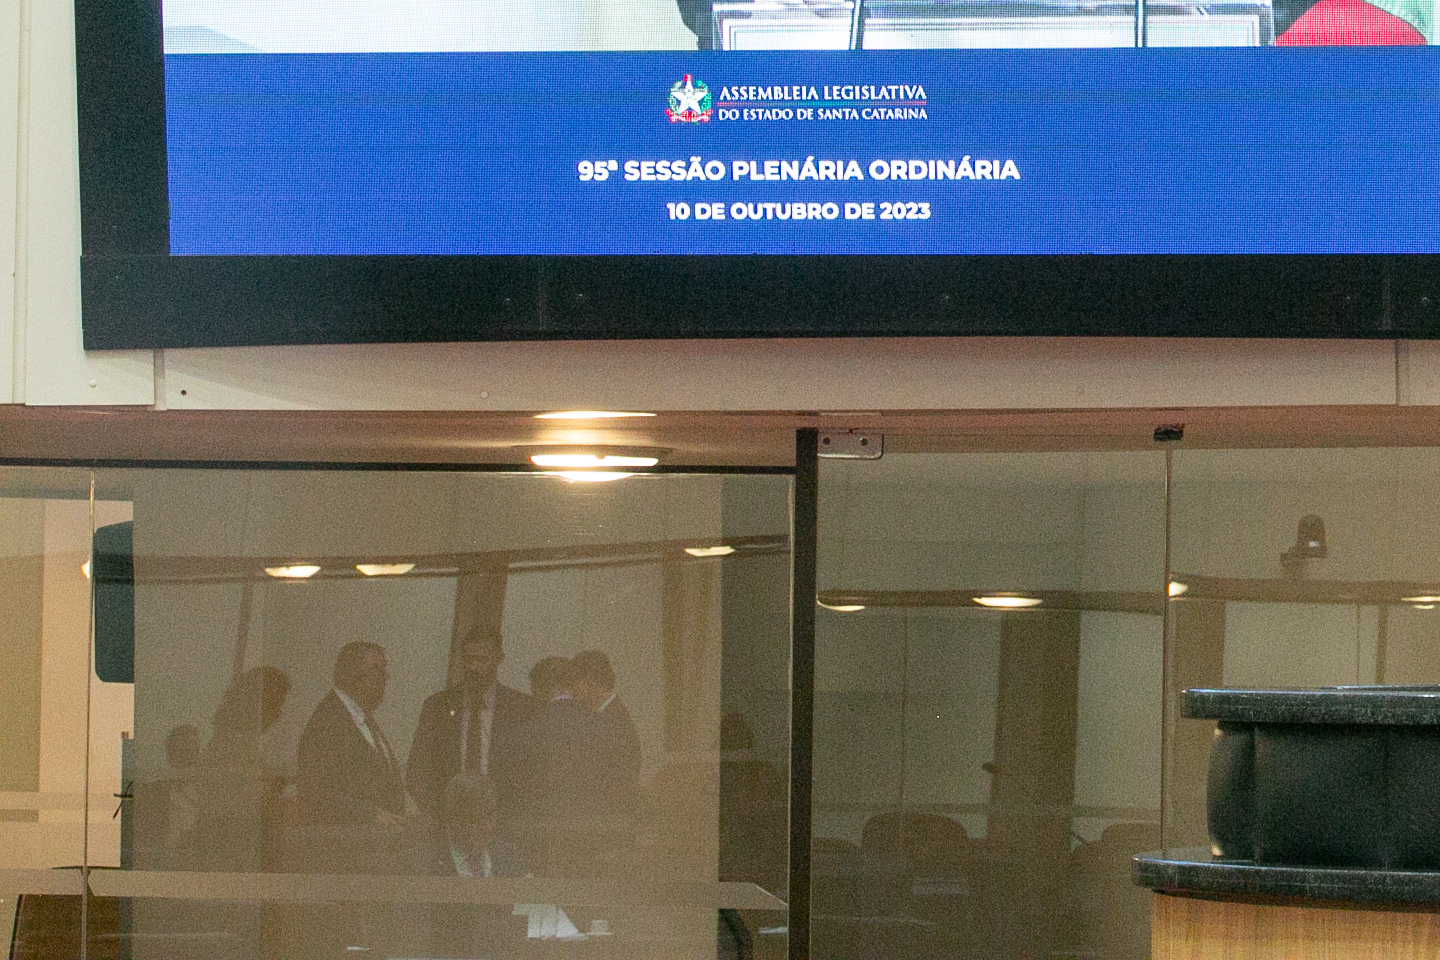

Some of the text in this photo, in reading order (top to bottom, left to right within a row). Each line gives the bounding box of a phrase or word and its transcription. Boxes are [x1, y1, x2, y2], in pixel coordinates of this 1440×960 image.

[719, 85, 928, 101] ASSEMBLEIA LEGISLATIVA
[718, 107, 928, 121] DO ESTADO DE SANTA CATARINA
[624, 156, 726, 181] SESSÃO
[733, 155, 864, 181] PLENÁRIA
[868, 155, 1021, 180] ORDINÁRIA
[667, 201, 931, 220] 10 DE OUTUBRO DE 2023
